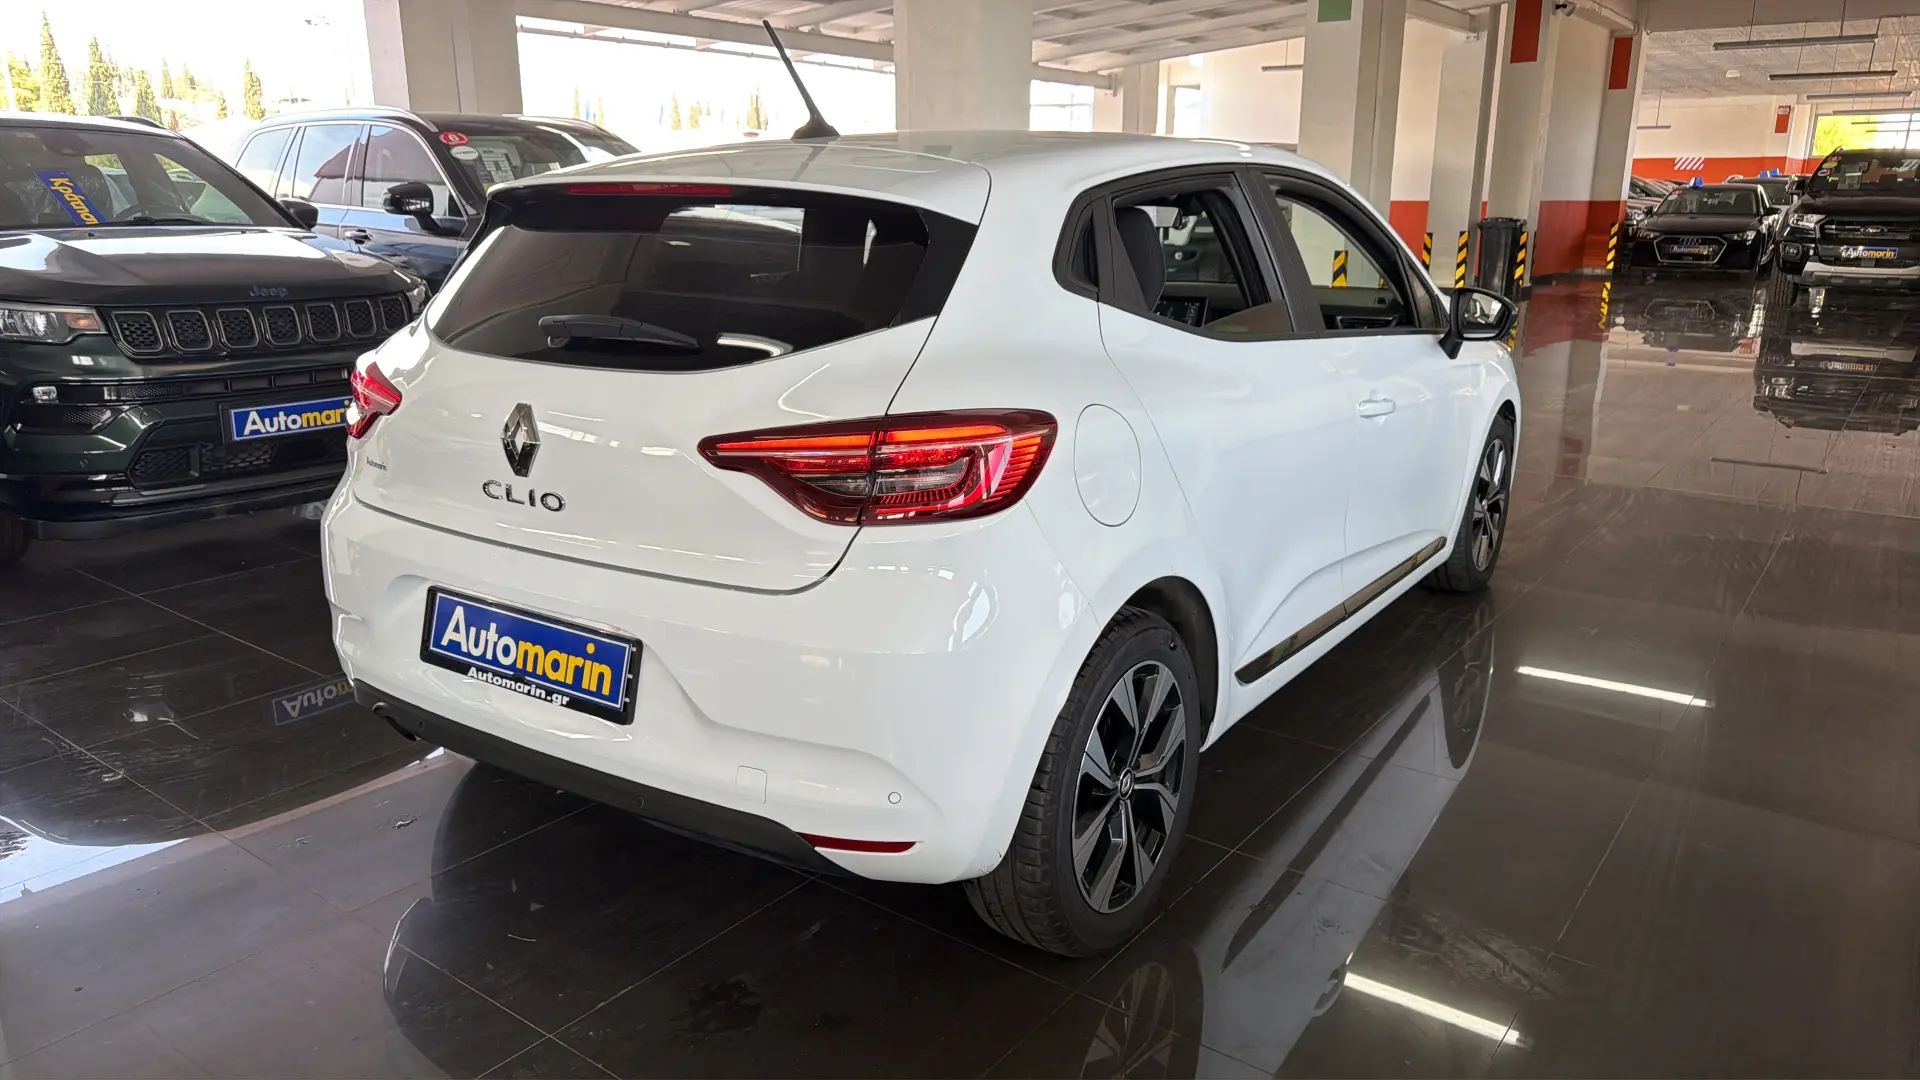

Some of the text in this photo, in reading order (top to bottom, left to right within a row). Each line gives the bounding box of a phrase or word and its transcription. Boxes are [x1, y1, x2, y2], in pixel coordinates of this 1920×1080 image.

[249, 285, 289, 297] Jeep
[482, 479, 566, 512] CLIO
[441, 605, 611, 695] Automarin
[467, 666, 570, 706] Automarin.gr
